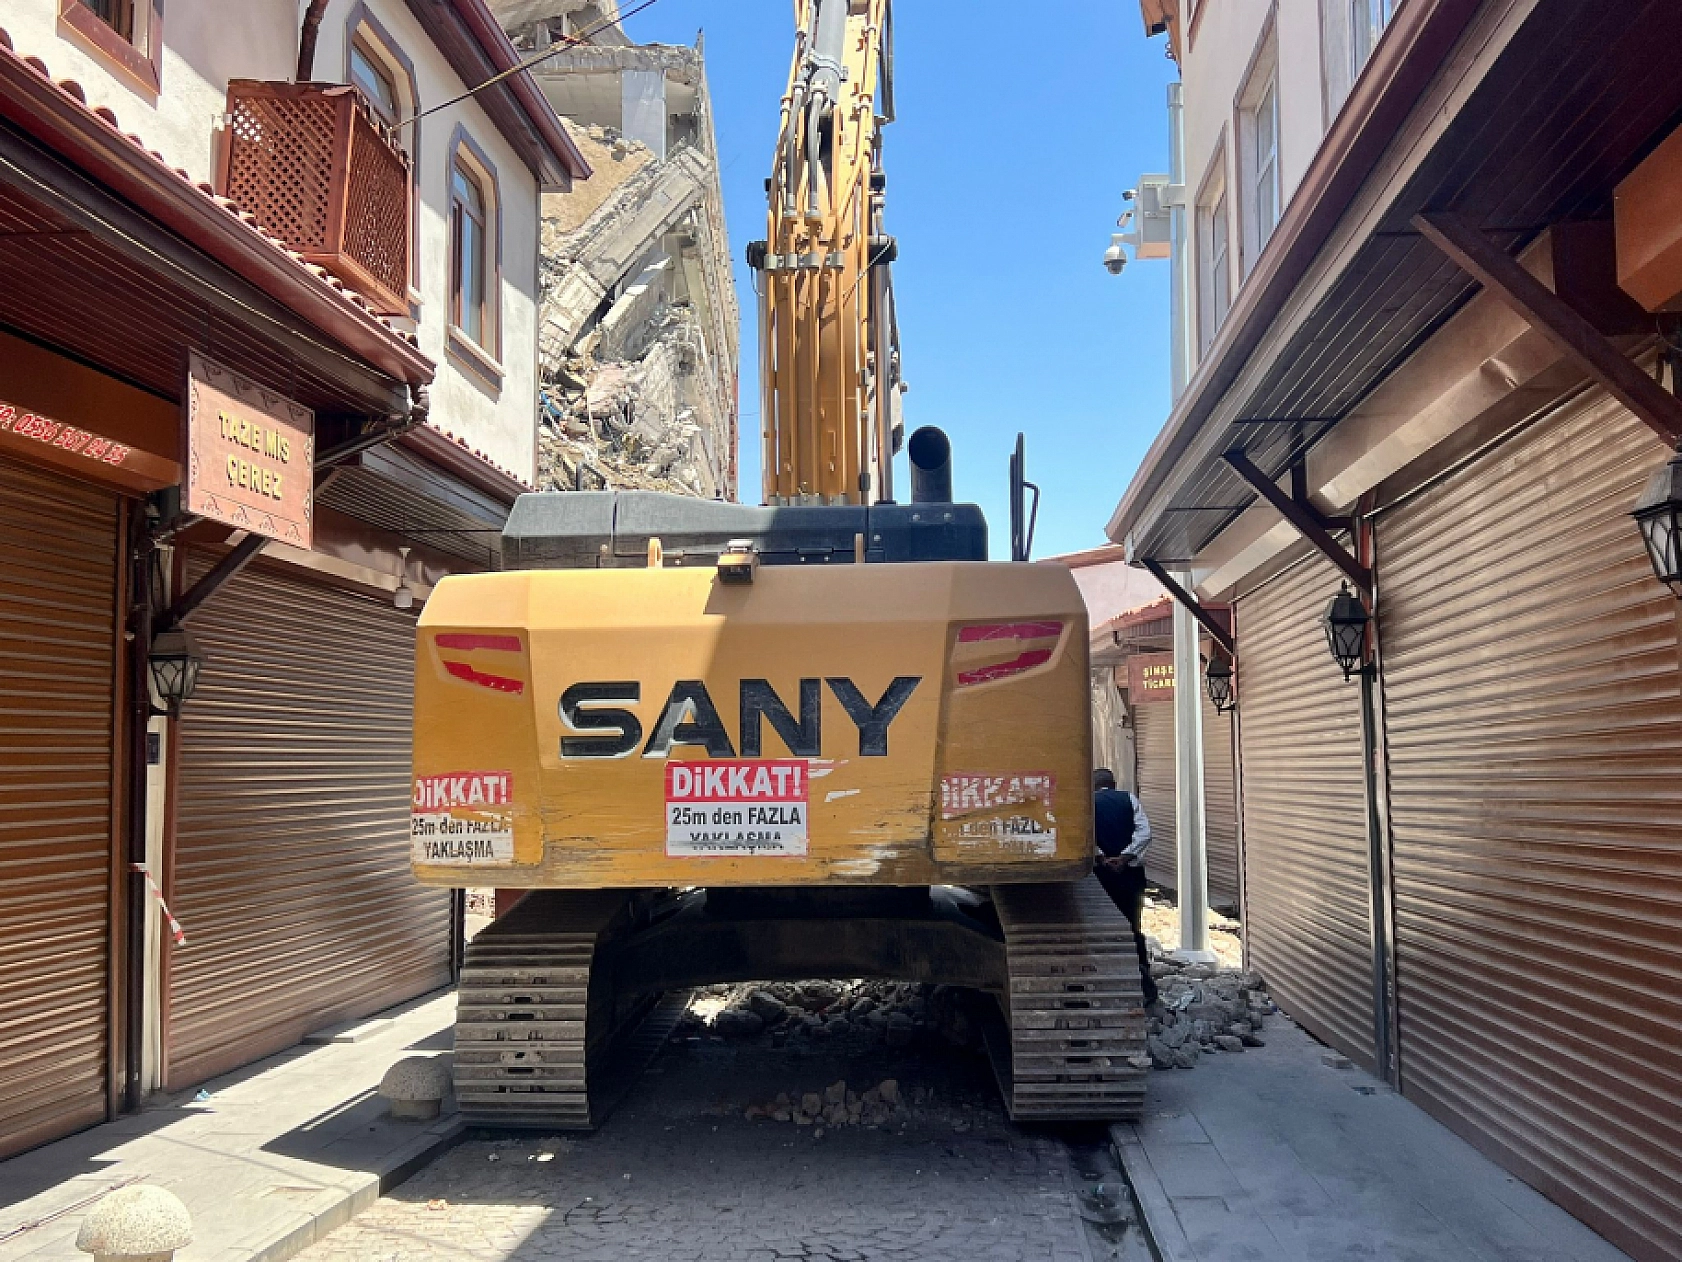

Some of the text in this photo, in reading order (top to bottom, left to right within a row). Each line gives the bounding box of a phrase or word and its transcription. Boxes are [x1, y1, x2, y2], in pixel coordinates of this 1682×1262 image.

[218, 410, 261, 453] TAZE
[226, 453, 283, 501] ÇEREZ
[559, 675, 924, 759] SANY
[412, 818, 435, 836] 25m
[439, 816, 463, 834] den
[672, 807, 802, 825] 25m den FAZLA
[423, 840, 494, 863] YAKLAŞMA
